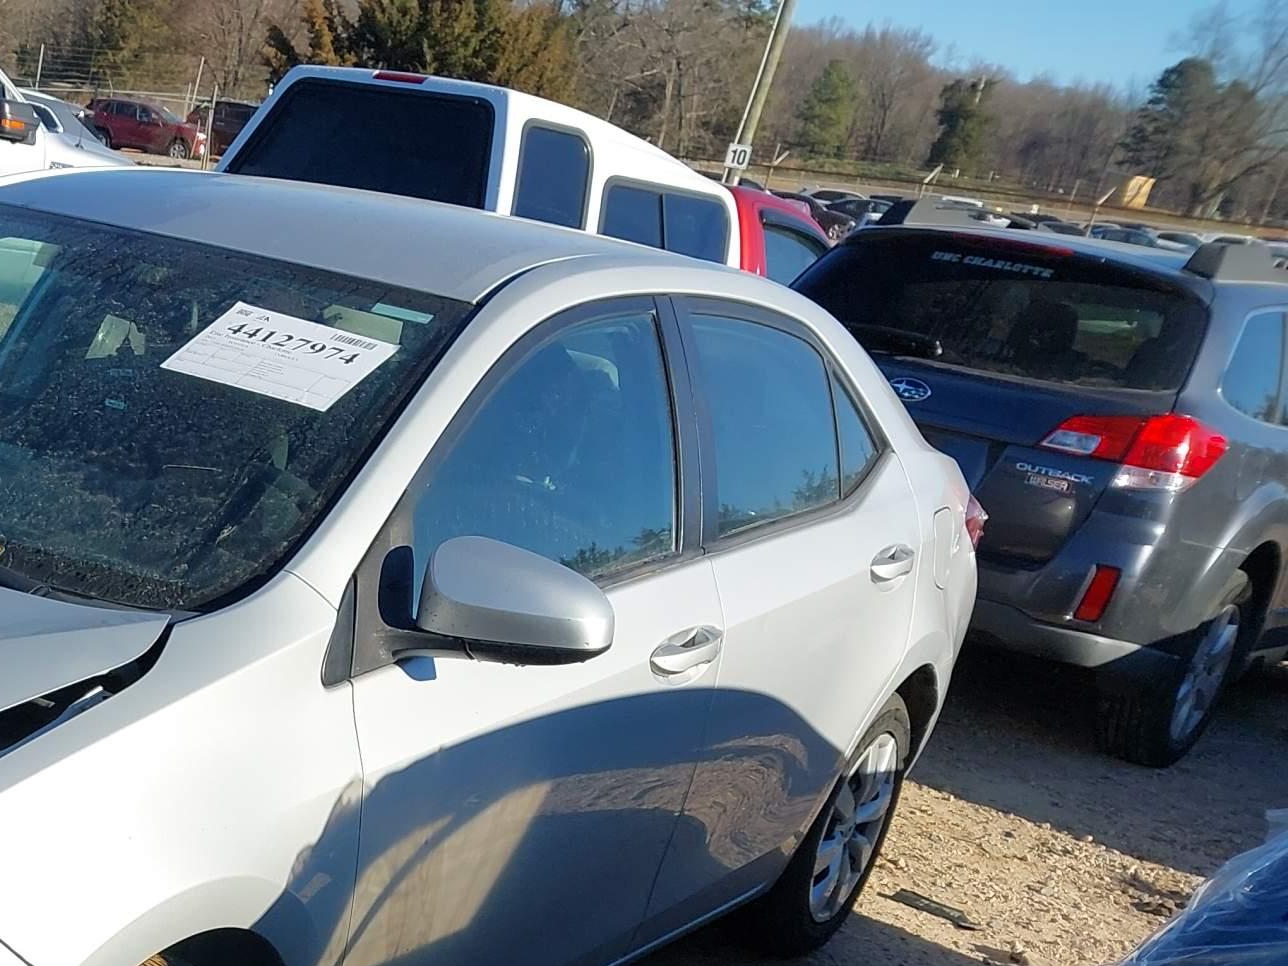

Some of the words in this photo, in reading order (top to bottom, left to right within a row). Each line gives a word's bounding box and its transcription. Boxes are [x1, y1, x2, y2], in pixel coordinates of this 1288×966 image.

[731, 148, 747, 165] 10
[963, 256, 1054, 277] CHARLOTTE
[227, 323, 360, 364] 44127974
[1016, 462, 1094, 484] OUTBACK
